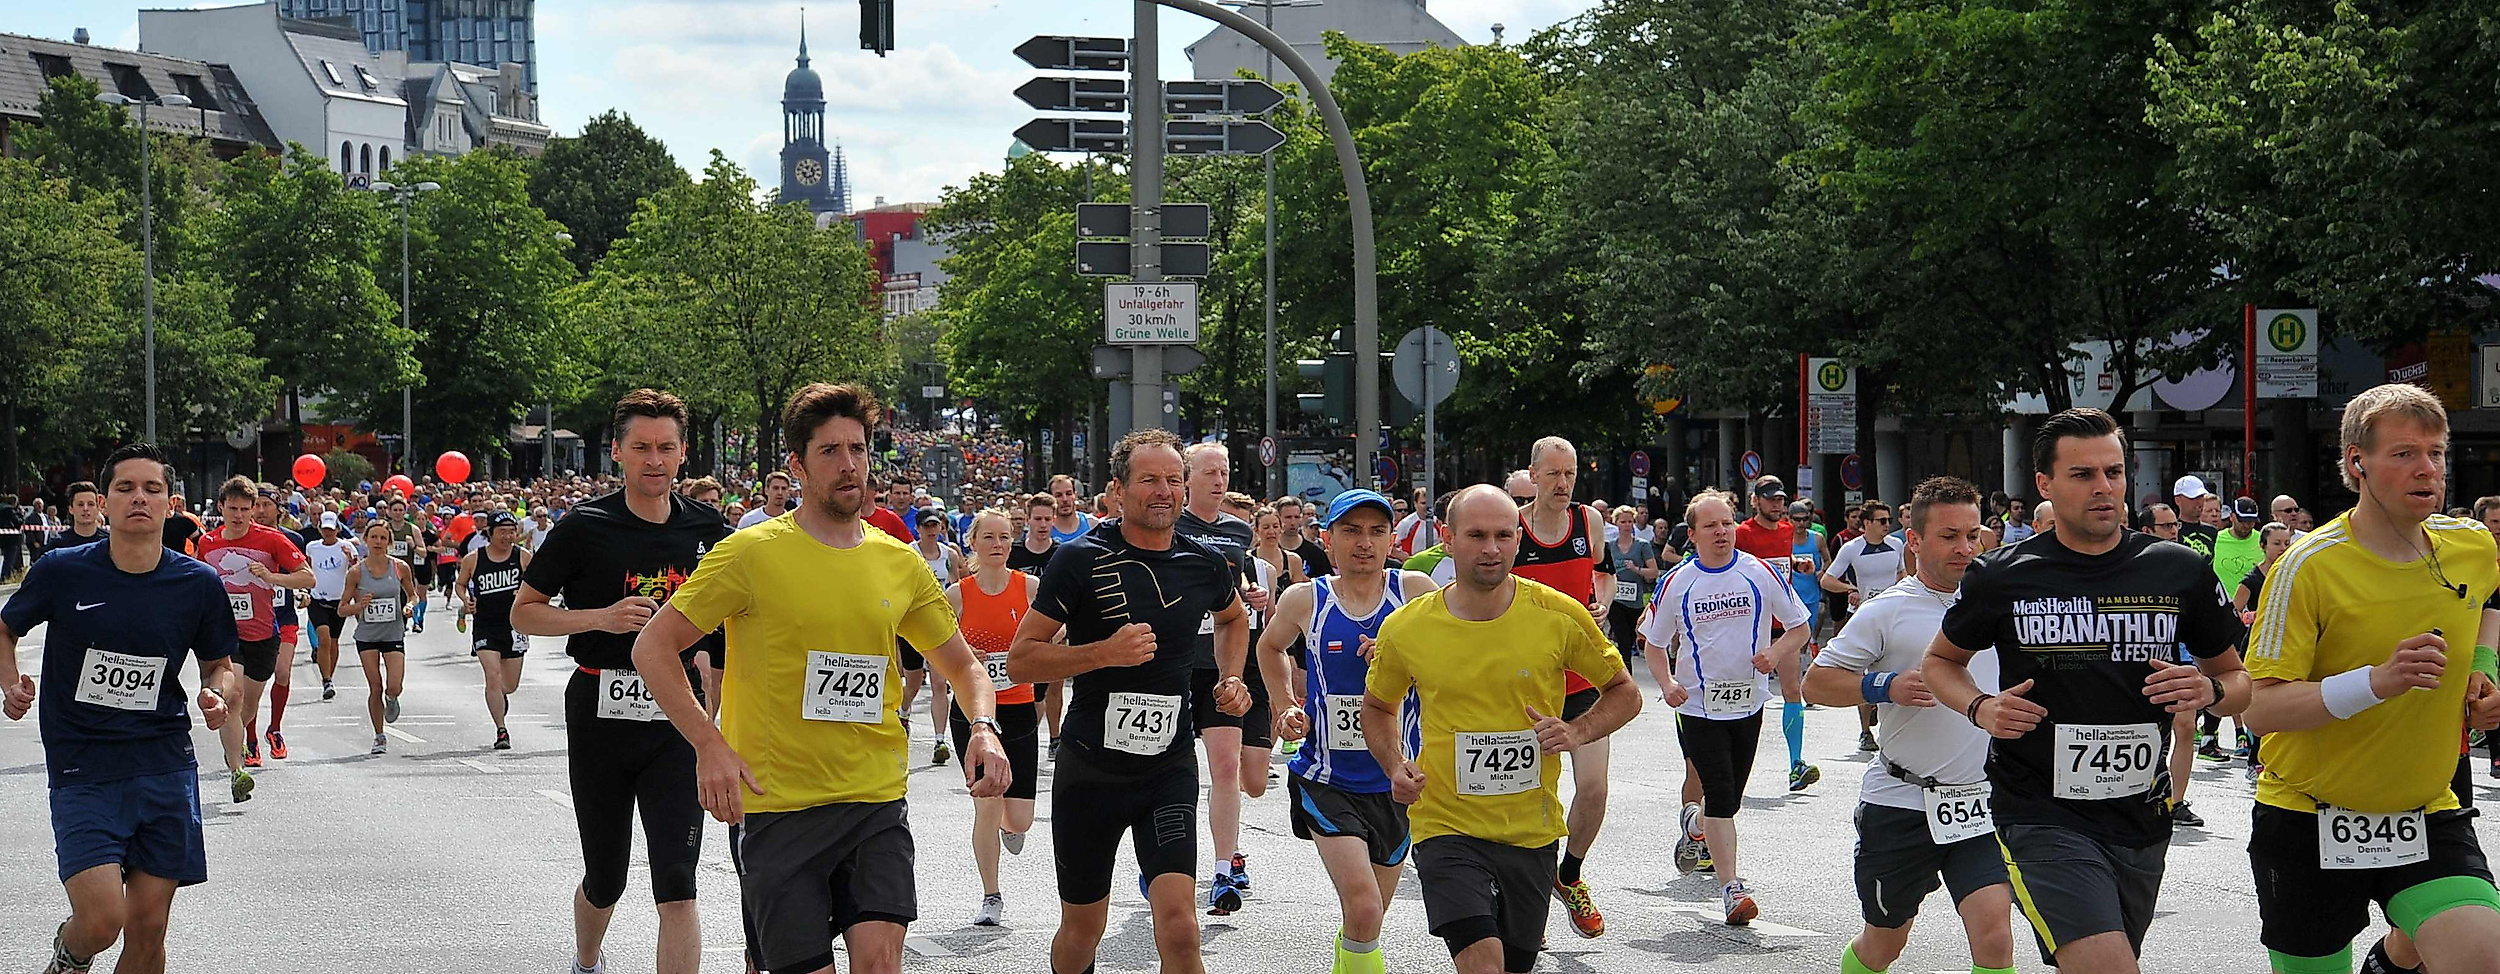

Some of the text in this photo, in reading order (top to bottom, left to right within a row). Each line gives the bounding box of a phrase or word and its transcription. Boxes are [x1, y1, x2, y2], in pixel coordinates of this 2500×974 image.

[1134, 286, 1145, 298] 19
[1119, 299, 1185, 311] Unfallgefahr
[1128, 313, 1176, 326] 30 km/h
[1115, 328, 1189, 339] Grüne Welle
[2278, 322, 2296, 343] H
[1825, 368, 1839, 384] H
[478, 568, 520, 591] 3RUN2
[1707, 591, 1735, 601] TEAM
[2097, 595, 2154, 605] HAMBURG
[367, 603, 394, 615] 6175
[1694, 596, 1751, 614] ERDINGER
[1695, 608, 1751, 621] ALKOHOLFREI
[2014, 613, 2178, 644] URBANATHLON
[2111, 643, 2121, 662] &
[101, 653, 125, 665] hella
[824, 655, 850, 668] hella
[91, 664, 156, 691] 3094
[817, 669, 879, 698] 7428
[106, 688, 136, 698] Michael
[1710, 687, 1752, 702] 7481
[629, 702, 651, 710] Klaus
[828, 698, 866, 707] Christoph
[1123, 695, 1147, 706] hella
[815, 707, 831, 715] hella
[1116, 708, 1173, 734] 7431
[1129, 732, 1161, 742] Bernhard
[1471, 735, 1497, 746] hella
[2075, 728, 2107, 741] hella
[1465, 745, 1535, 773] 7429
[2068, 742, 2153, 773] 7450
[1490, 773, 1514, 781] Micha
[2095, 774, 2125, 783] Daniel
[1468, 783, 1486, 791] hella
[2069, 786, 2090, 794] hella
[1940, 788, 1961, 799] hella
[1960, 820, 1986, 830] Holger
[2331, 815, 2418, 844] 6346
[2357, 845, 2392, 854] Dennis
[2335, 856, 2356, 864] hella
